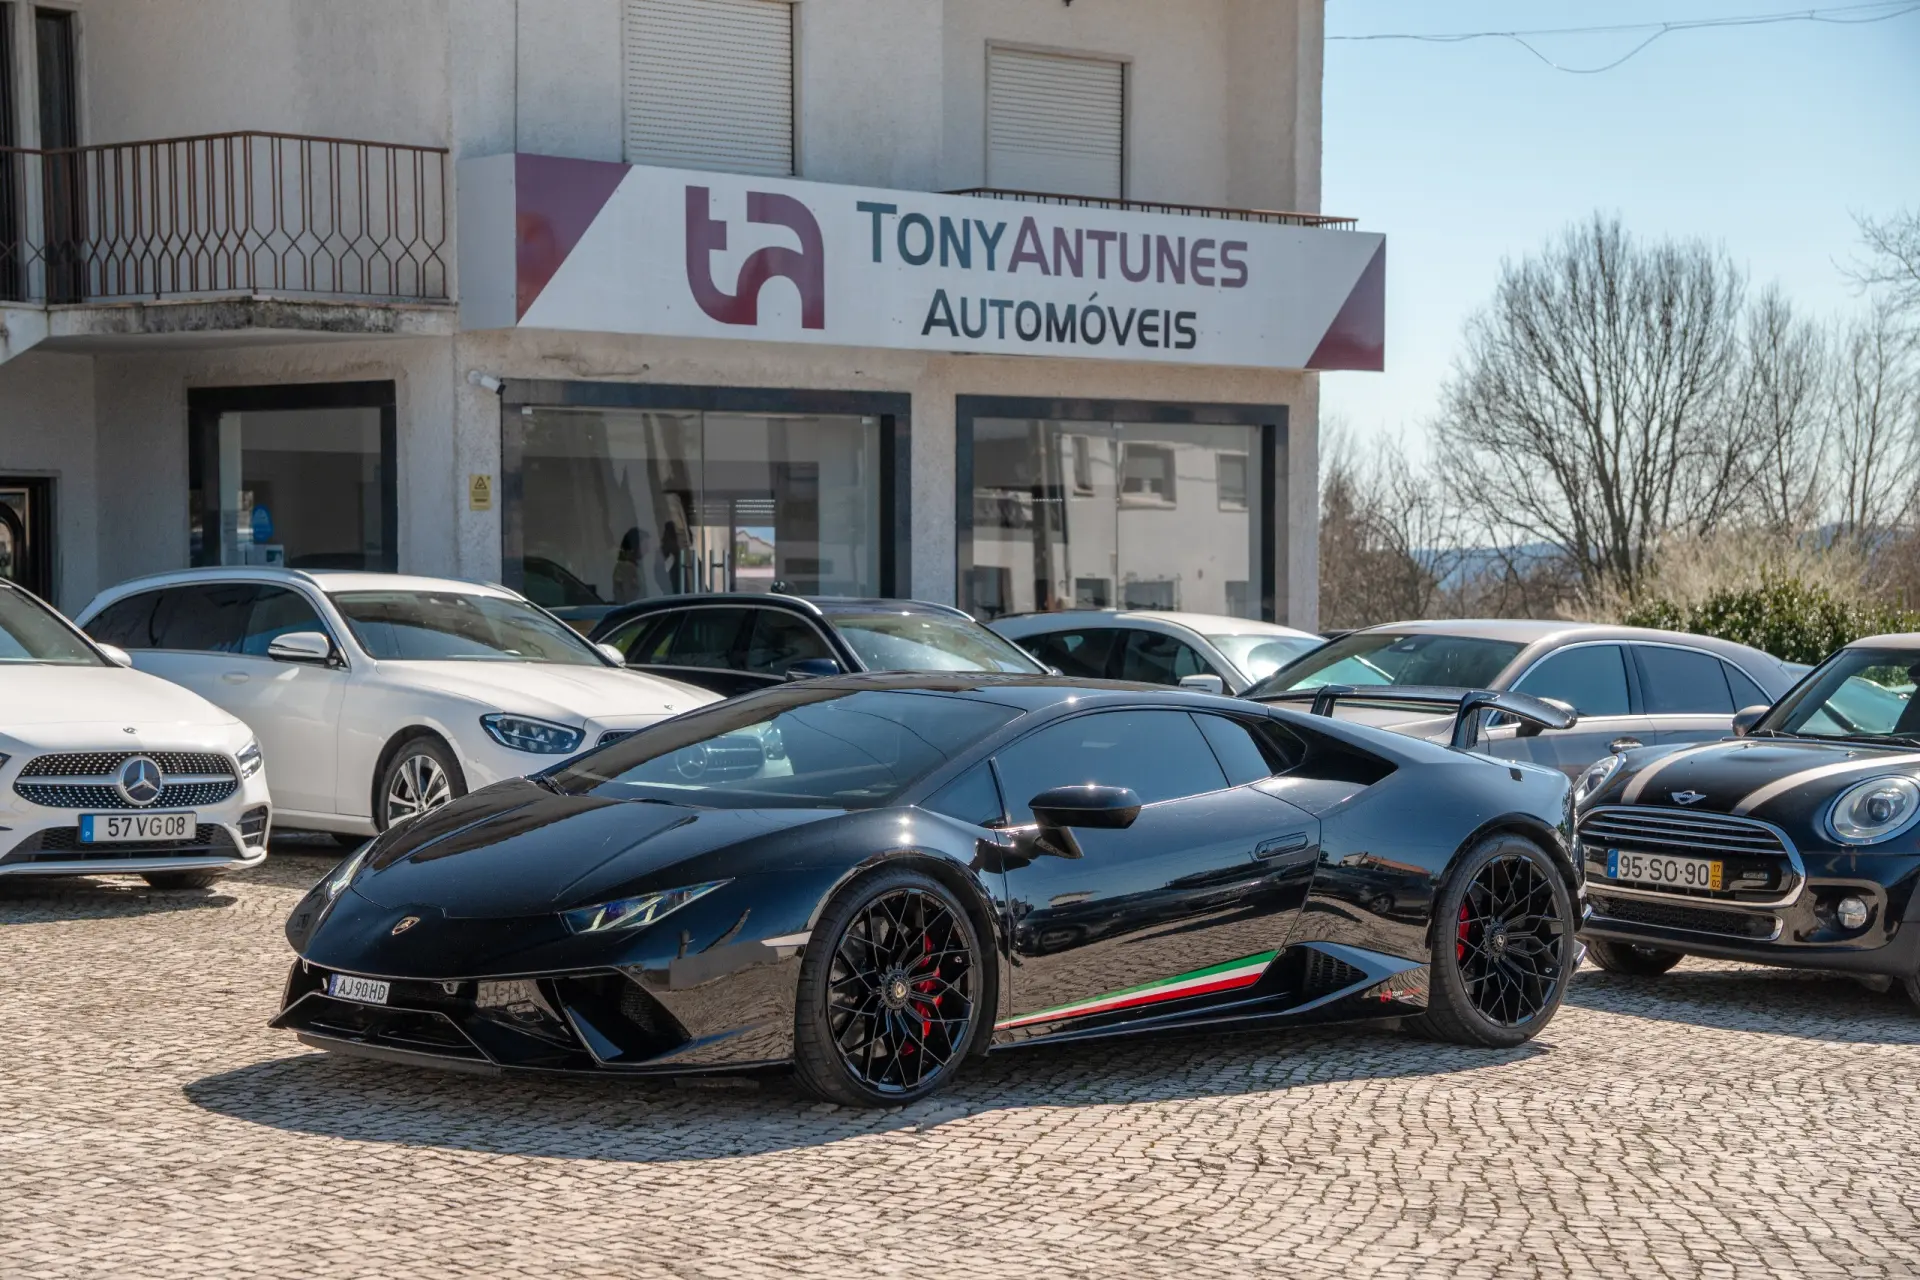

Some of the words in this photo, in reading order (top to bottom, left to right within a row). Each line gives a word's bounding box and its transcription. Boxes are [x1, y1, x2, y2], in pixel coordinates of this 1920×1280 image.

[921, 288, 1197, 349] AUTOMÓVEIS
[1712, 864, 1721, 873] 17
[1711, 879, 1721, 889] 02
